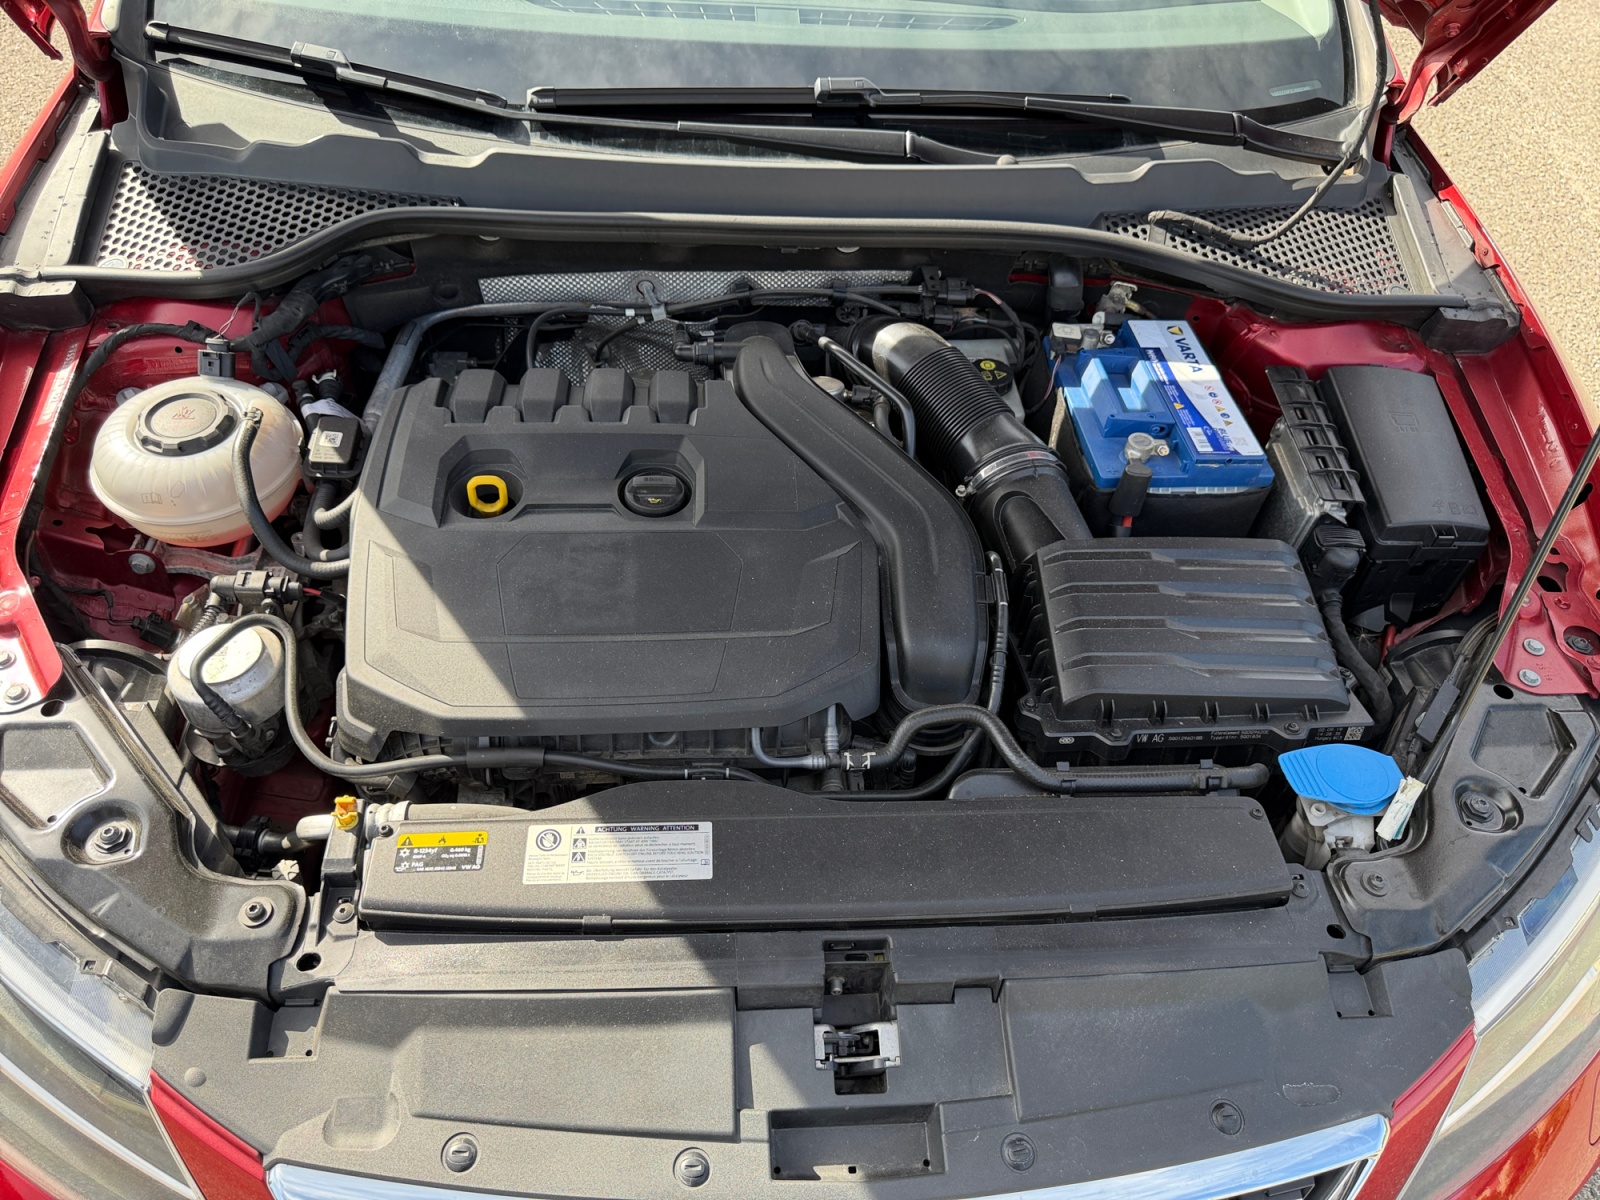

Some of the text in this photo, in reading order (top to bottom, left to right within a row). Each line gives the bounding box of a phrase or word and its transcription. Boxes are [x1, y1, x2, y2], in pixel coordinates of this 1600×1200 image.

[1175, 338, 1203, 373] VARTA
[1136, 734, 1149, 743] VW
[1151, 733, 1165, 743] AG
